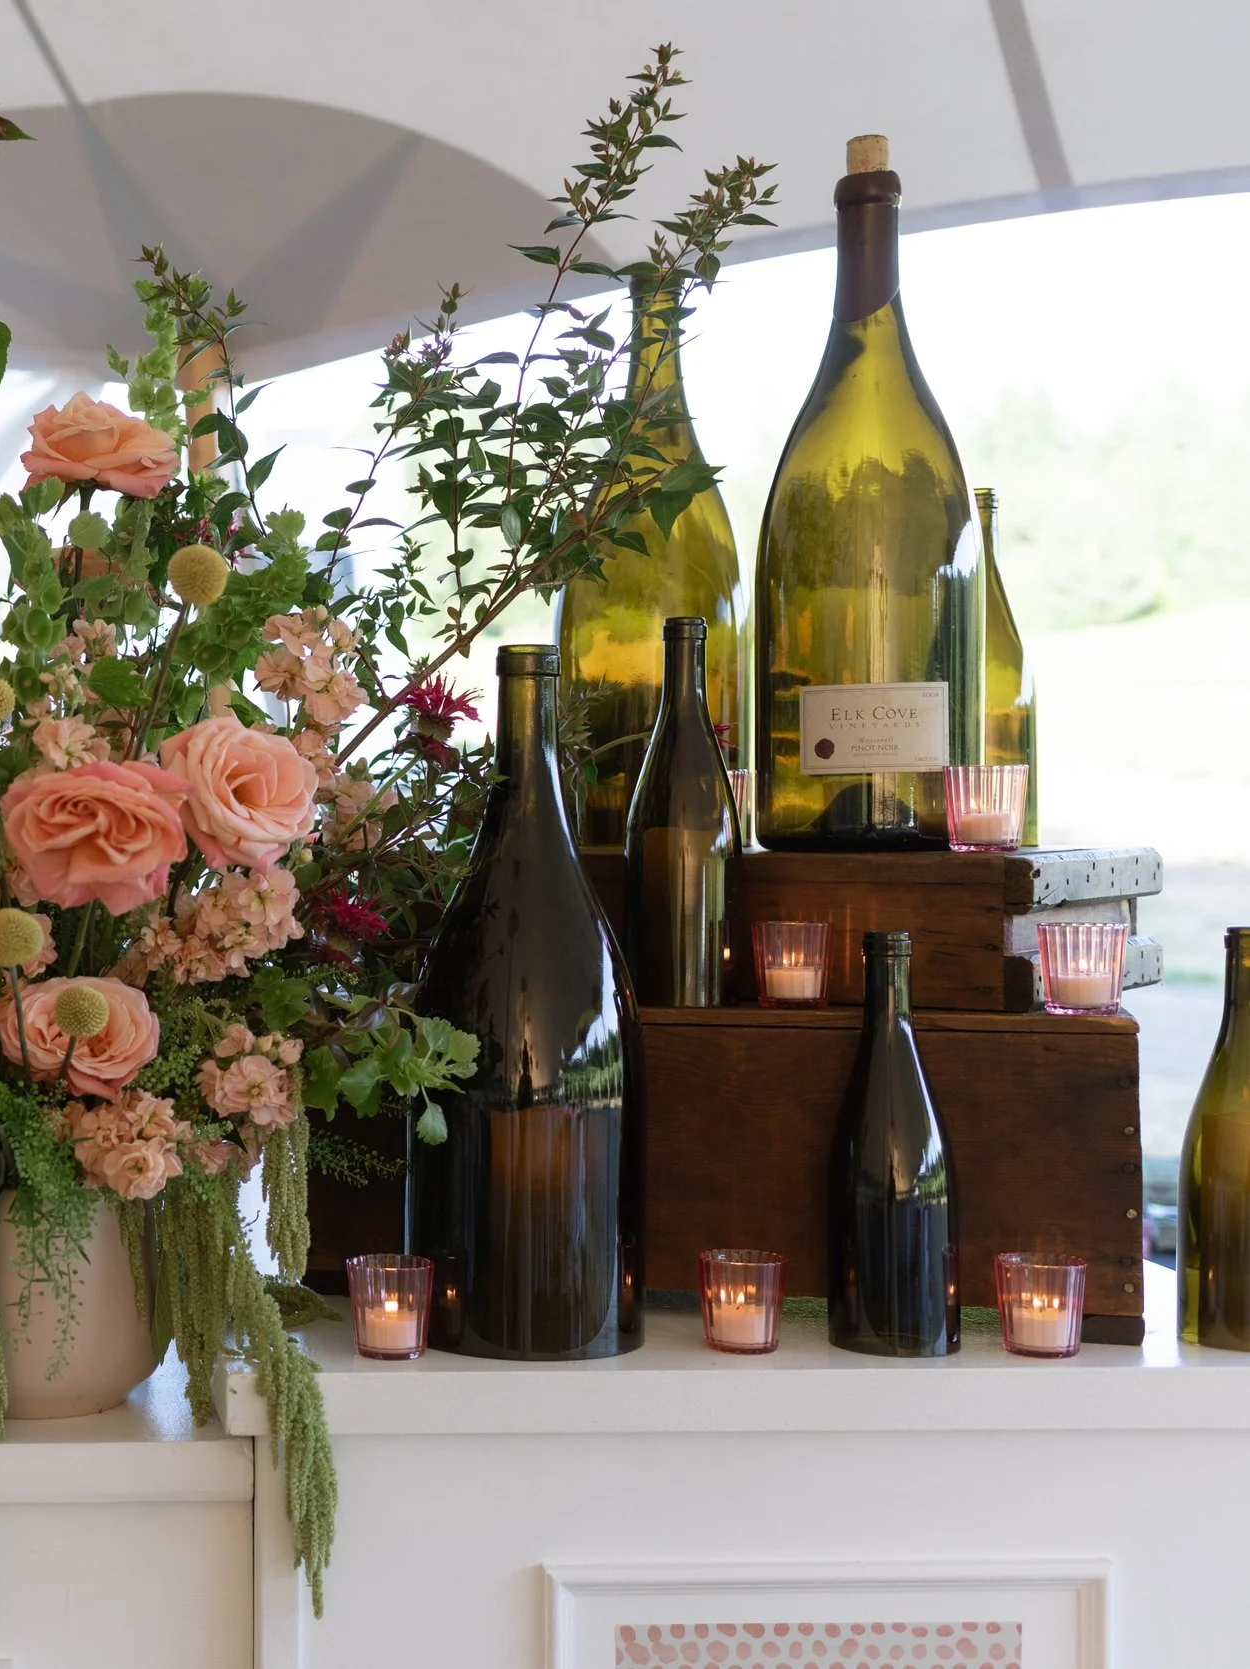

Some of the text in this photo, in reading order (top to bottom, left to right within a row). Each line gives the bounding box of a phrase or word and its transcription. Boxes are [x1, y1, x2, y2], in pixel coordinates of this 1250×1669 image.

[829, 721, 921, 730] VINEYARDS
[851, 744, 899, 752] PINOT NOIR
